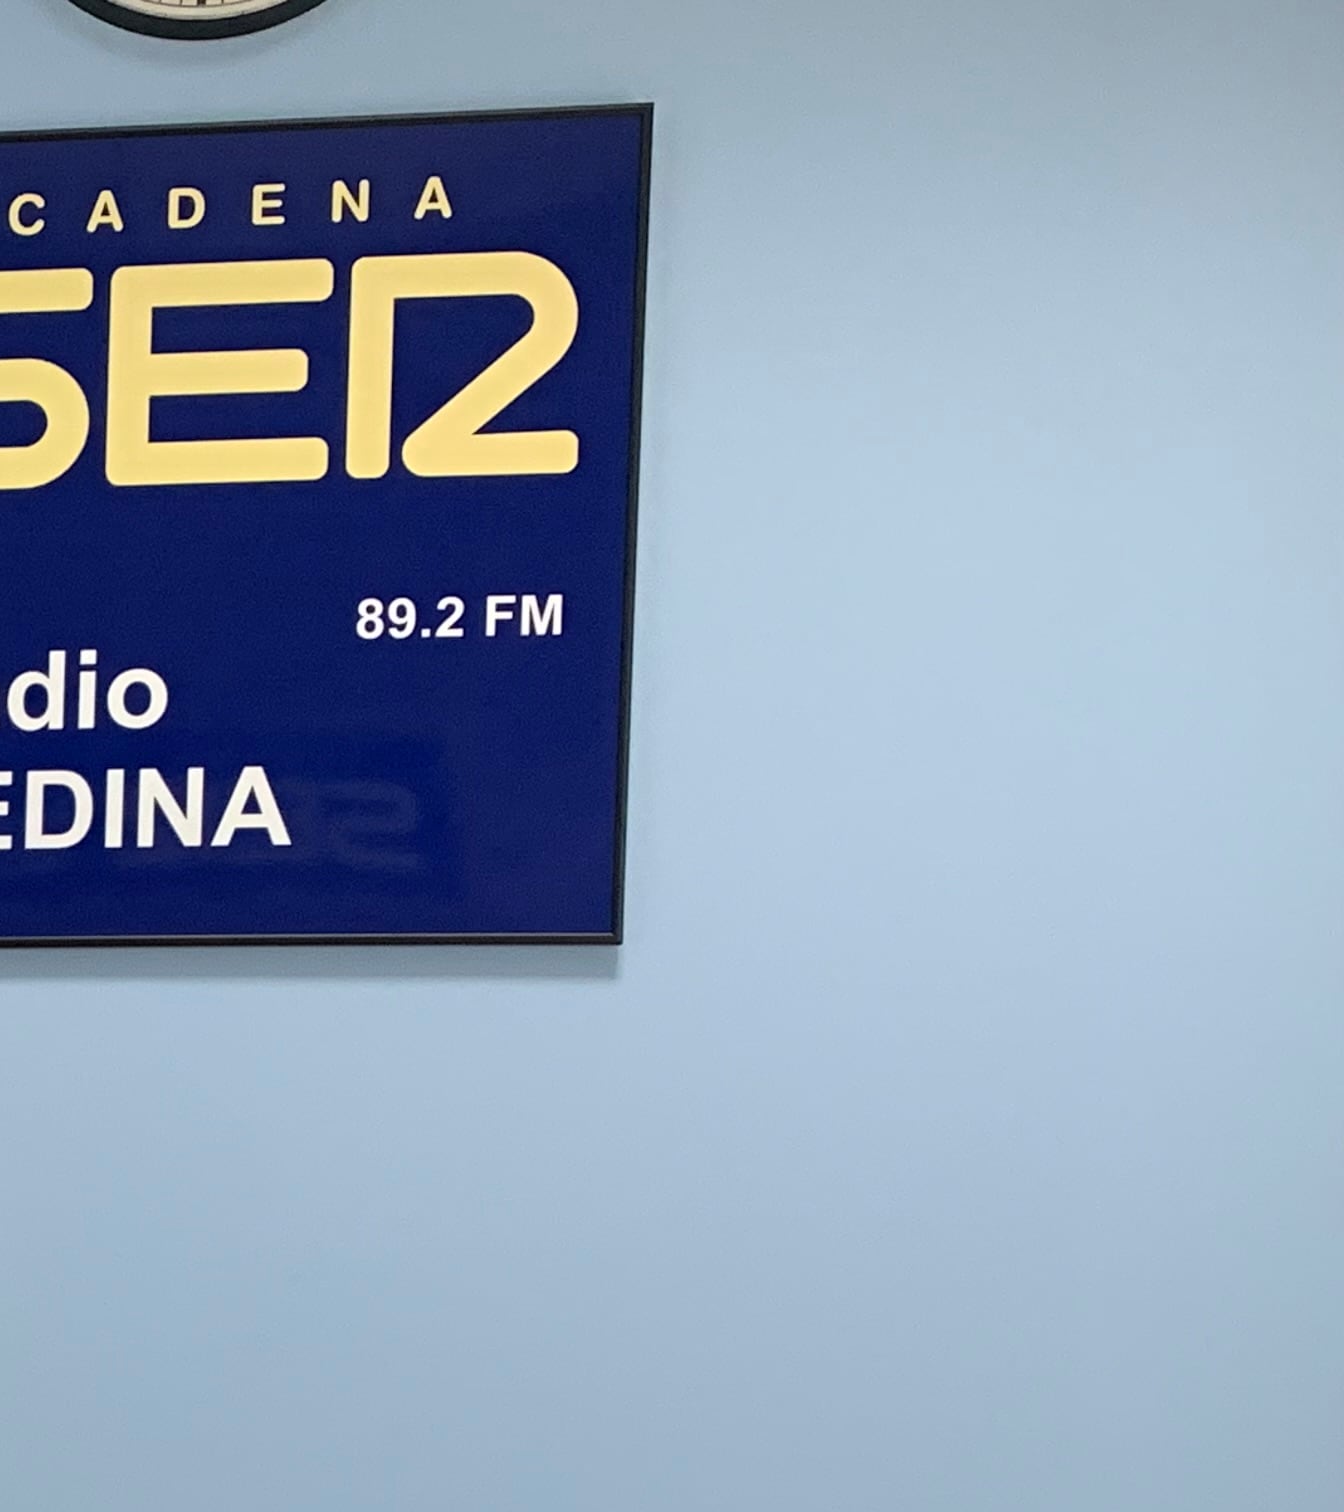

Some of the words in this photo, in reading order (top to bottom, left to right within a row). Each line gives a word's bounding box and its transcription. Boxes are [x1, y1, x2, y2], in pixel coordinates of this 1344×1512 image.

[8, 176, 453, 236] CADENA
[355, 597, 465, 640] 89.2
[484, 594, 565, 638] FM
